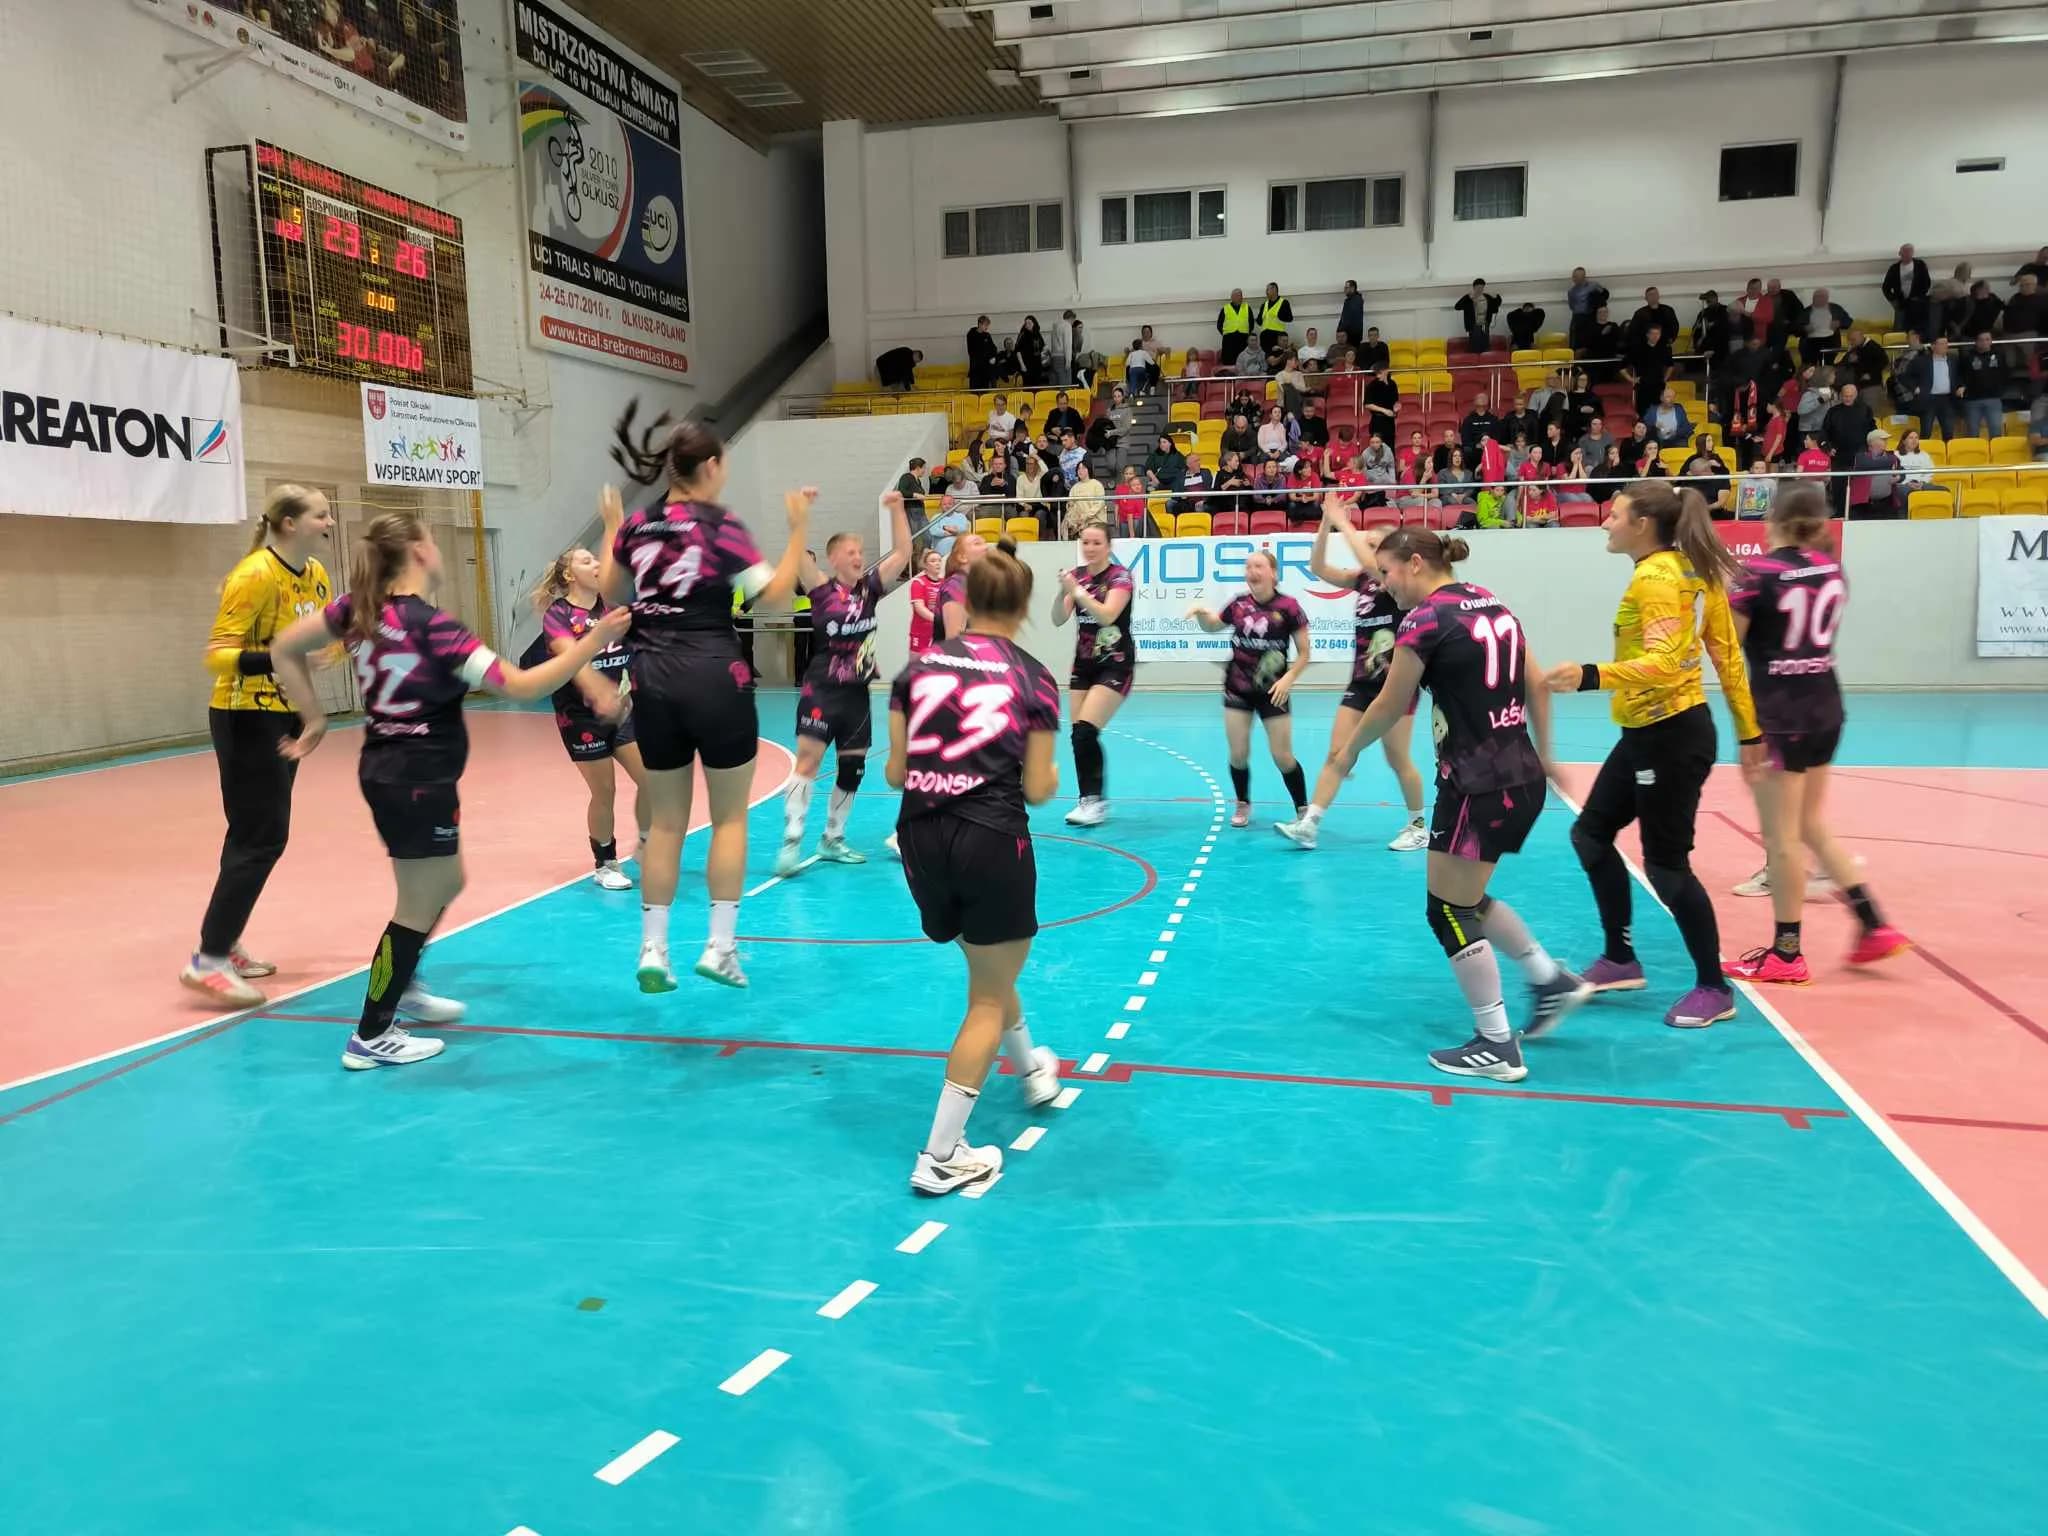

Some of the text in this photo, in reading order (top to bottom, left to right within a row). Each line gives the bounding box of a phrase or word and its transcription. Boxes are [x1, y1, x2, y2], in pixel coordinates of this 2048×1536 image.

[519, 3, 677, 126] MISTRZOSTWA ŚWIATA
[533, 45, 670, 141] DO LAT 16 W TRIALU ROWEROWYM
[590, 146, 618, 179] 2010
[582, 181, 620, 212] OLKUSZ
[293, 207, 302, 225] 5
[323, 215, 361, 260] 23
[395, 239, 428, 280] 26
[533, 242, 688, 313] UCI TRIALS WORLD YOUTH GAMES
[367, 290, 395, 312] 0.00
[621, 308, 686, 343] OLKUSZ-POLAND
[549, 323, 684, 370] www.trial.srebrnemiasto.eu
[0, 390, 192, 461] REATON
[375, 463, 481, 485] WSPIERAMY SPORT
[1110, 541, 1320, 585] MOSR
[2007, 530, 2048, 561] M
[630, 541, 703, 601] 24
[1138, 588, 1205, 600] KUSZ
[1777, 579, 1847, 650] 10
[1139, 639, 1177, 650] Wiejska
[1179, 639, 1189, 649] 1a
[1196, 639, 1236, 650] www.m
[1314, 639, 1327, 649] 32
[1329, 639, 1348, 649] 649
[592, 654, 631, 670] SUZU
[907, 674, 1015, 760] 23
[905, 768, 985, 796] DOWSK
